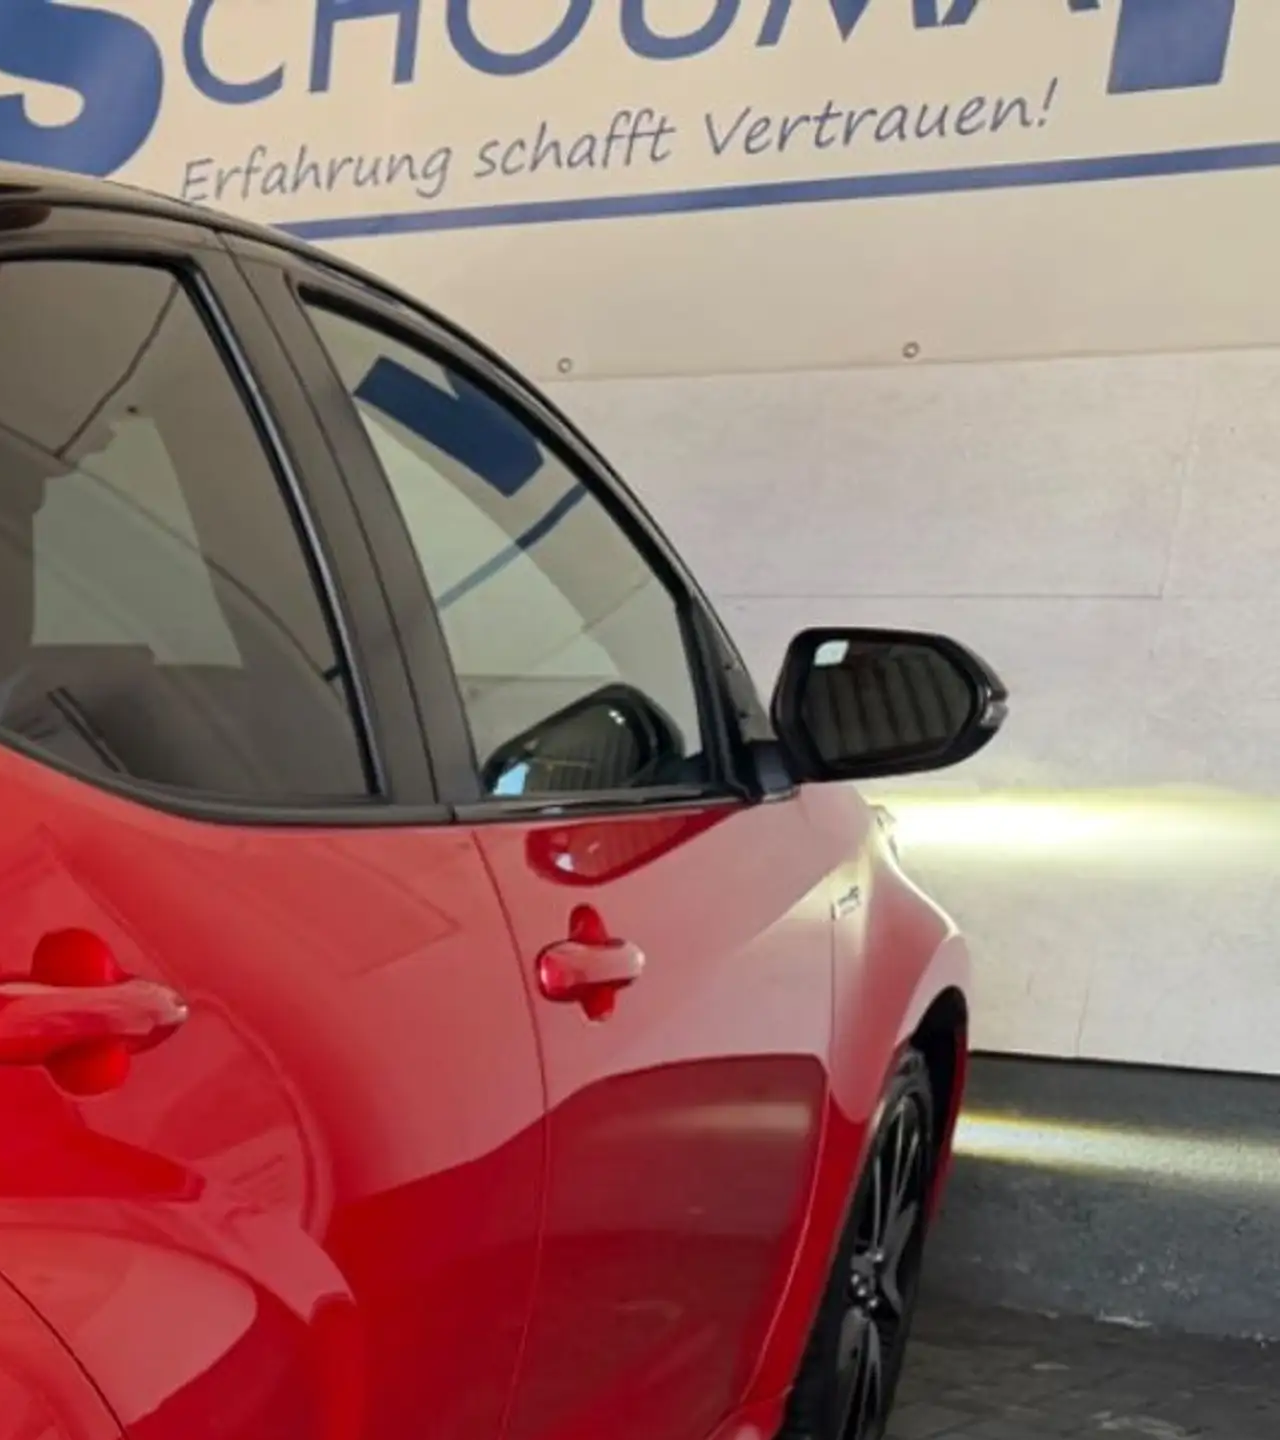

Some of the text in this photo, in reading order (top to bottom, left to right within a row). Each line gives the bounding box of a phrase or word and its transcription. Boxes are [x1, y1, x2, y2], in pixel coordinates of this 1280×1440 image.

[180, 76, 1058, 200] Erfahrung schafft Vertrauen!
